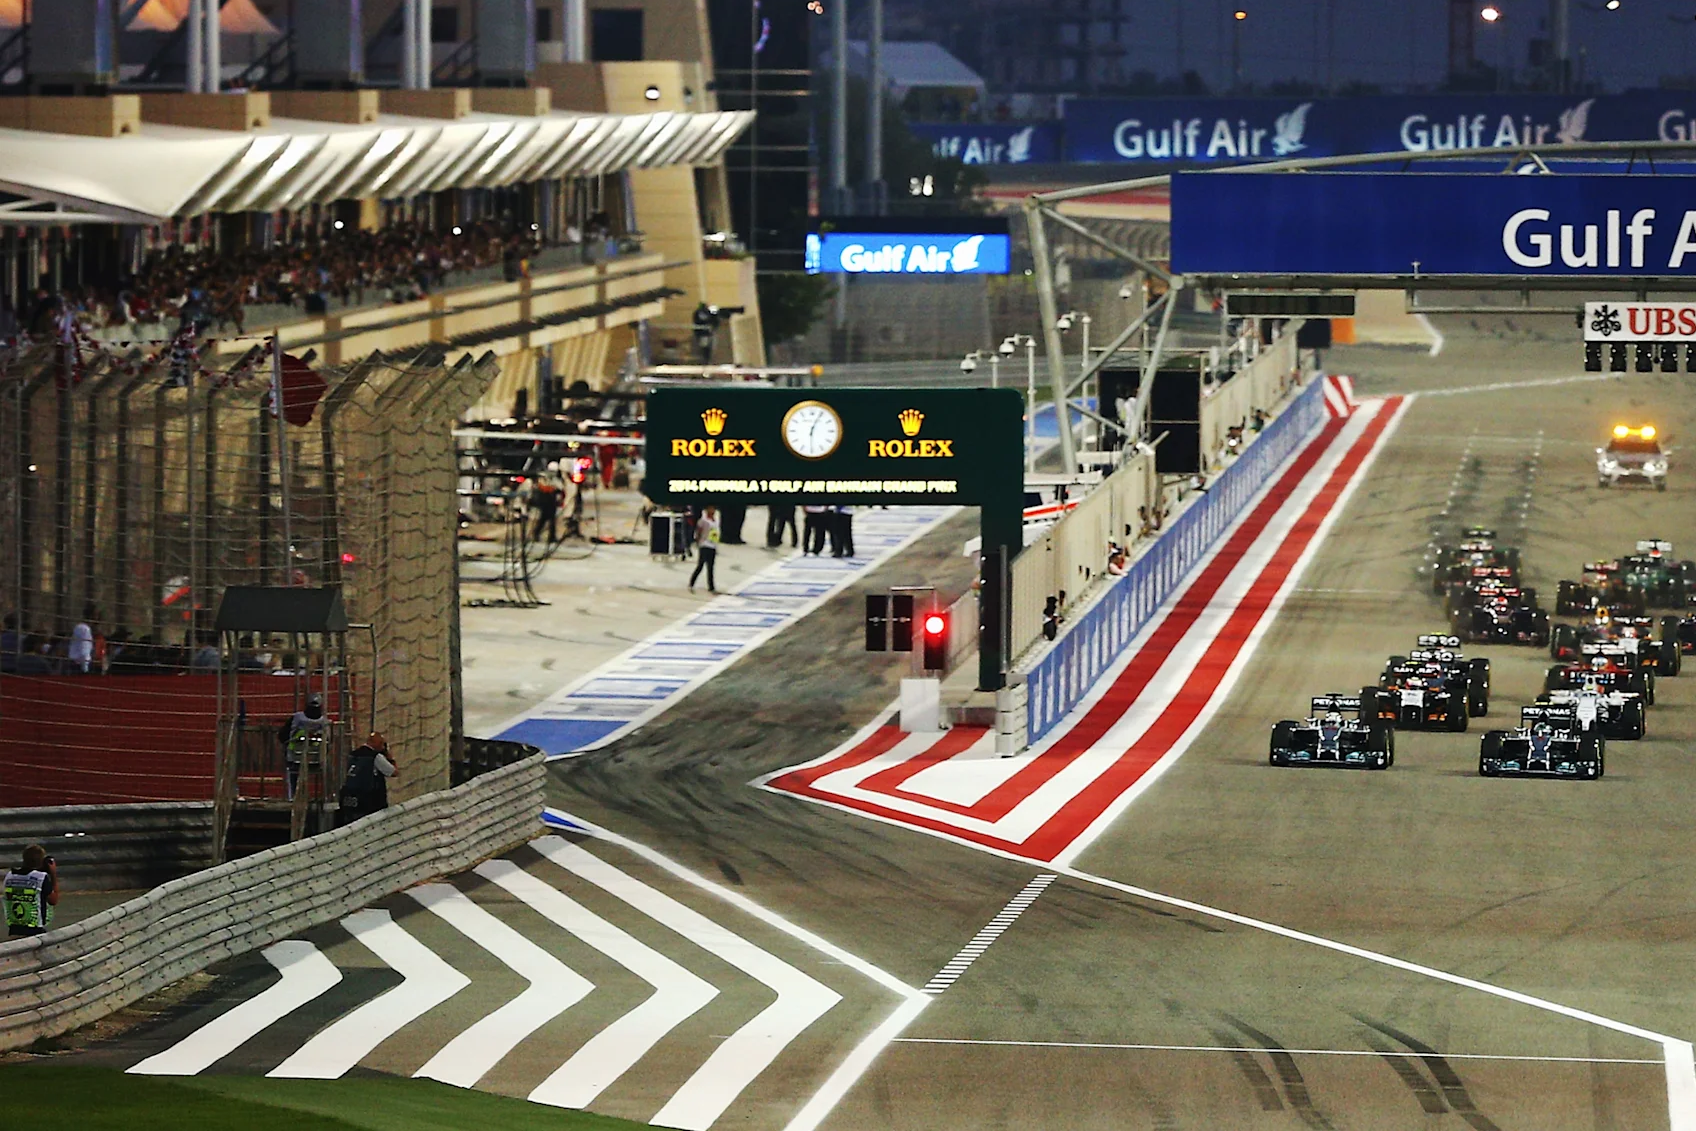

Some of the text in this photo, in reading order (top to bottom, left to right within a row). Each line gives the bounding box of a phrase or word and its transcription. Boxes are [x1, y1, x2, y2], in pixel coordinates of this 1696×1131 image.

[1113, 118, 1267, 158] Gulf Air
[1400, 114, 1550, 151] Gulf Air
[963, 137, 1004, 165] Air
[1502, 208, 1656, 269] Gulf
[840, 244, 952, 273] Gulf Air
[671, 439, 757, 457] ROLEX
[868, 439, 954, 458] ROLEX
[1313, 698, 1361, 706] PETONAS
[1522, 707, 1571, 715] PETONAS
